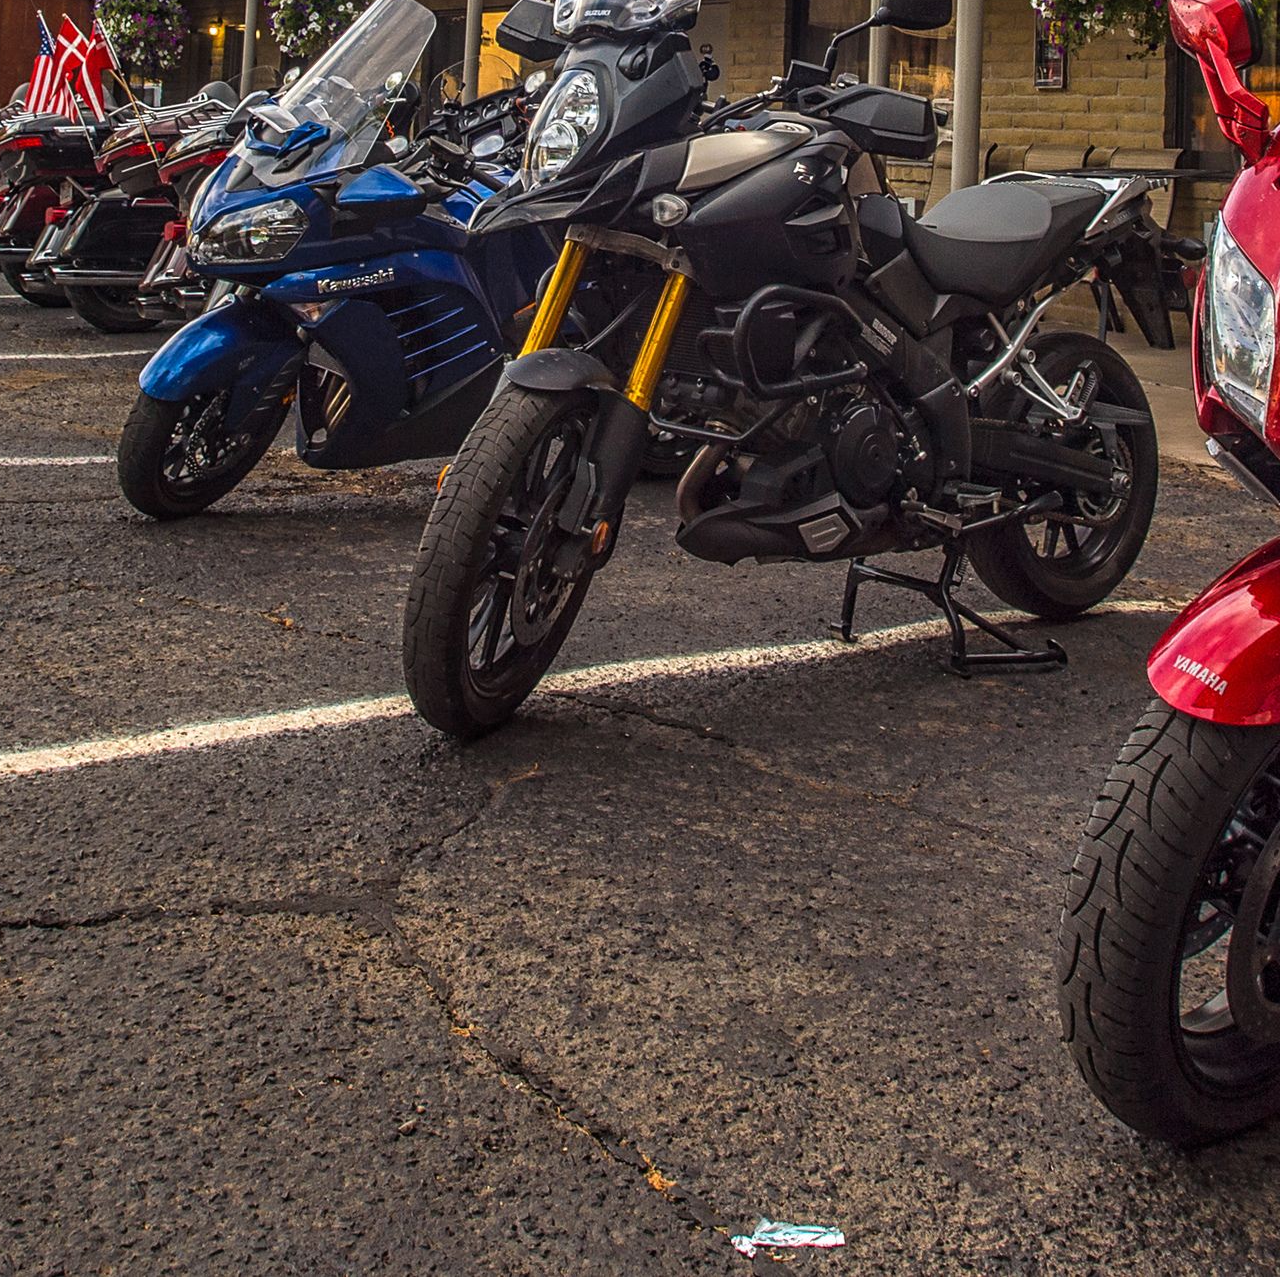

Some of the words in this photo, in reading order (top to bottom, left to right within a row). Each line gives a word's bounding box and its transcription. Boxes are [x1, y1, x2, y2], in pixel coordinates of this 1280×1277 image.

[584, 9, 612, 17] SUZUKI
[317, 268, 396, 294] Kawasaki
[1173, 654, 1229, 696] YAMAHA
